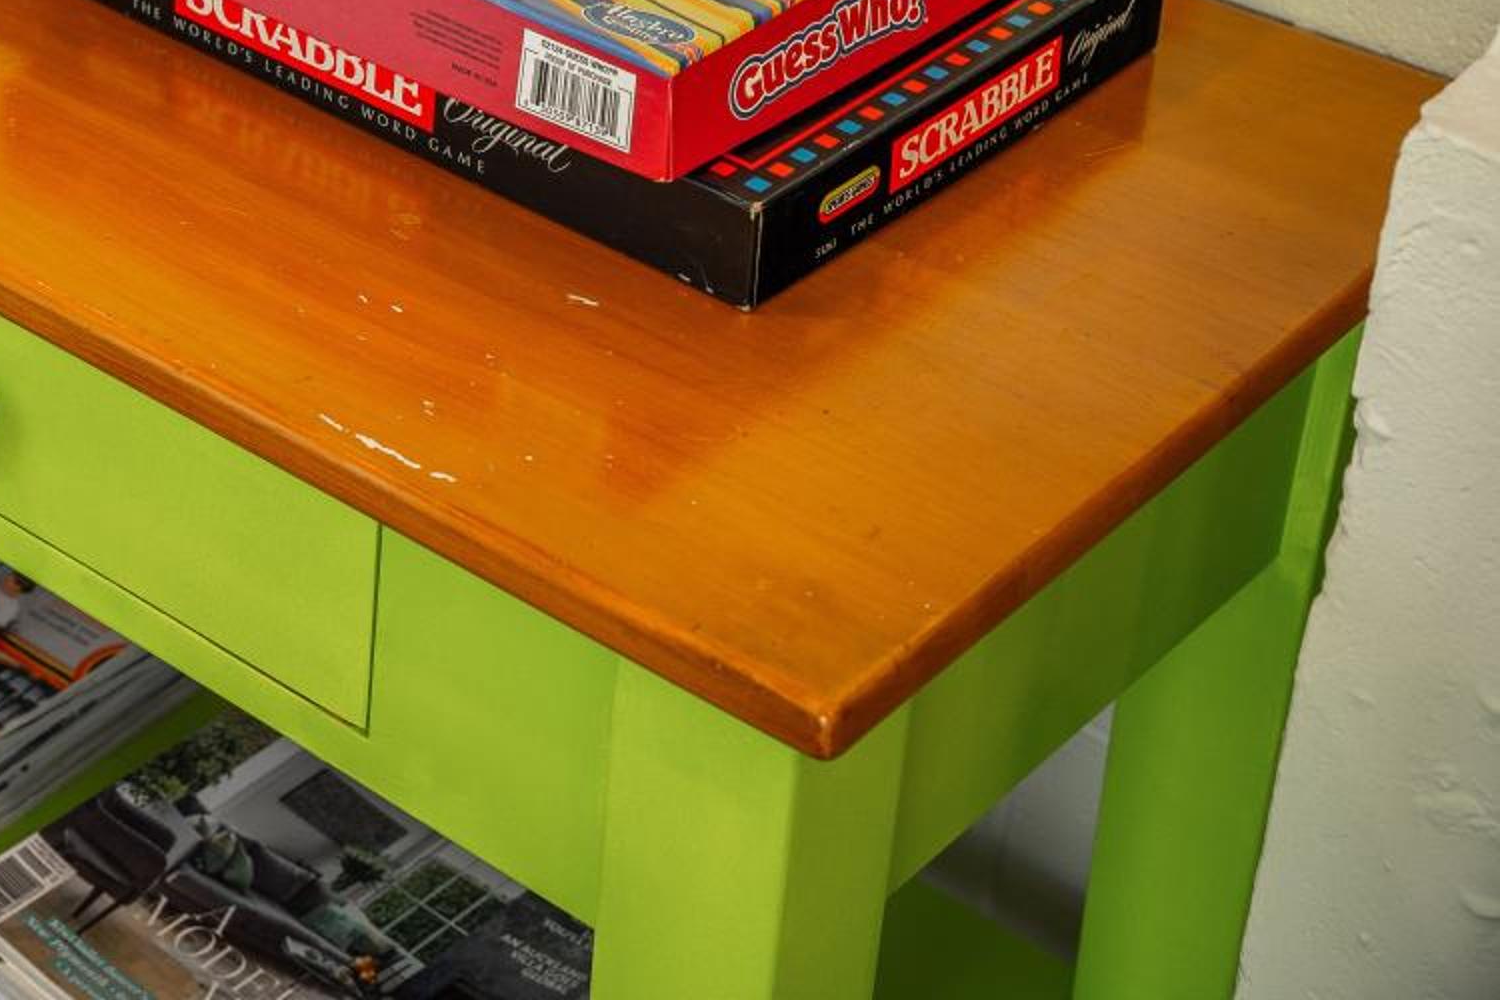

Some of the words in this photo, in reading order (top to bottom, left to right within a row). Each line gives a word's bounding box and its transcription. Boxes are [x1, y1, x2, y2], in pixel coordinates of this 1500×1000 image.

[173, 15, 253, 64] WORLD'S
[265, 60, 349, 110] LEADING
[360, 104, 417, 141] WORD
[427, 136, 486, 175] GAME
[898, 50, 1054, 179] SCRABBLE
